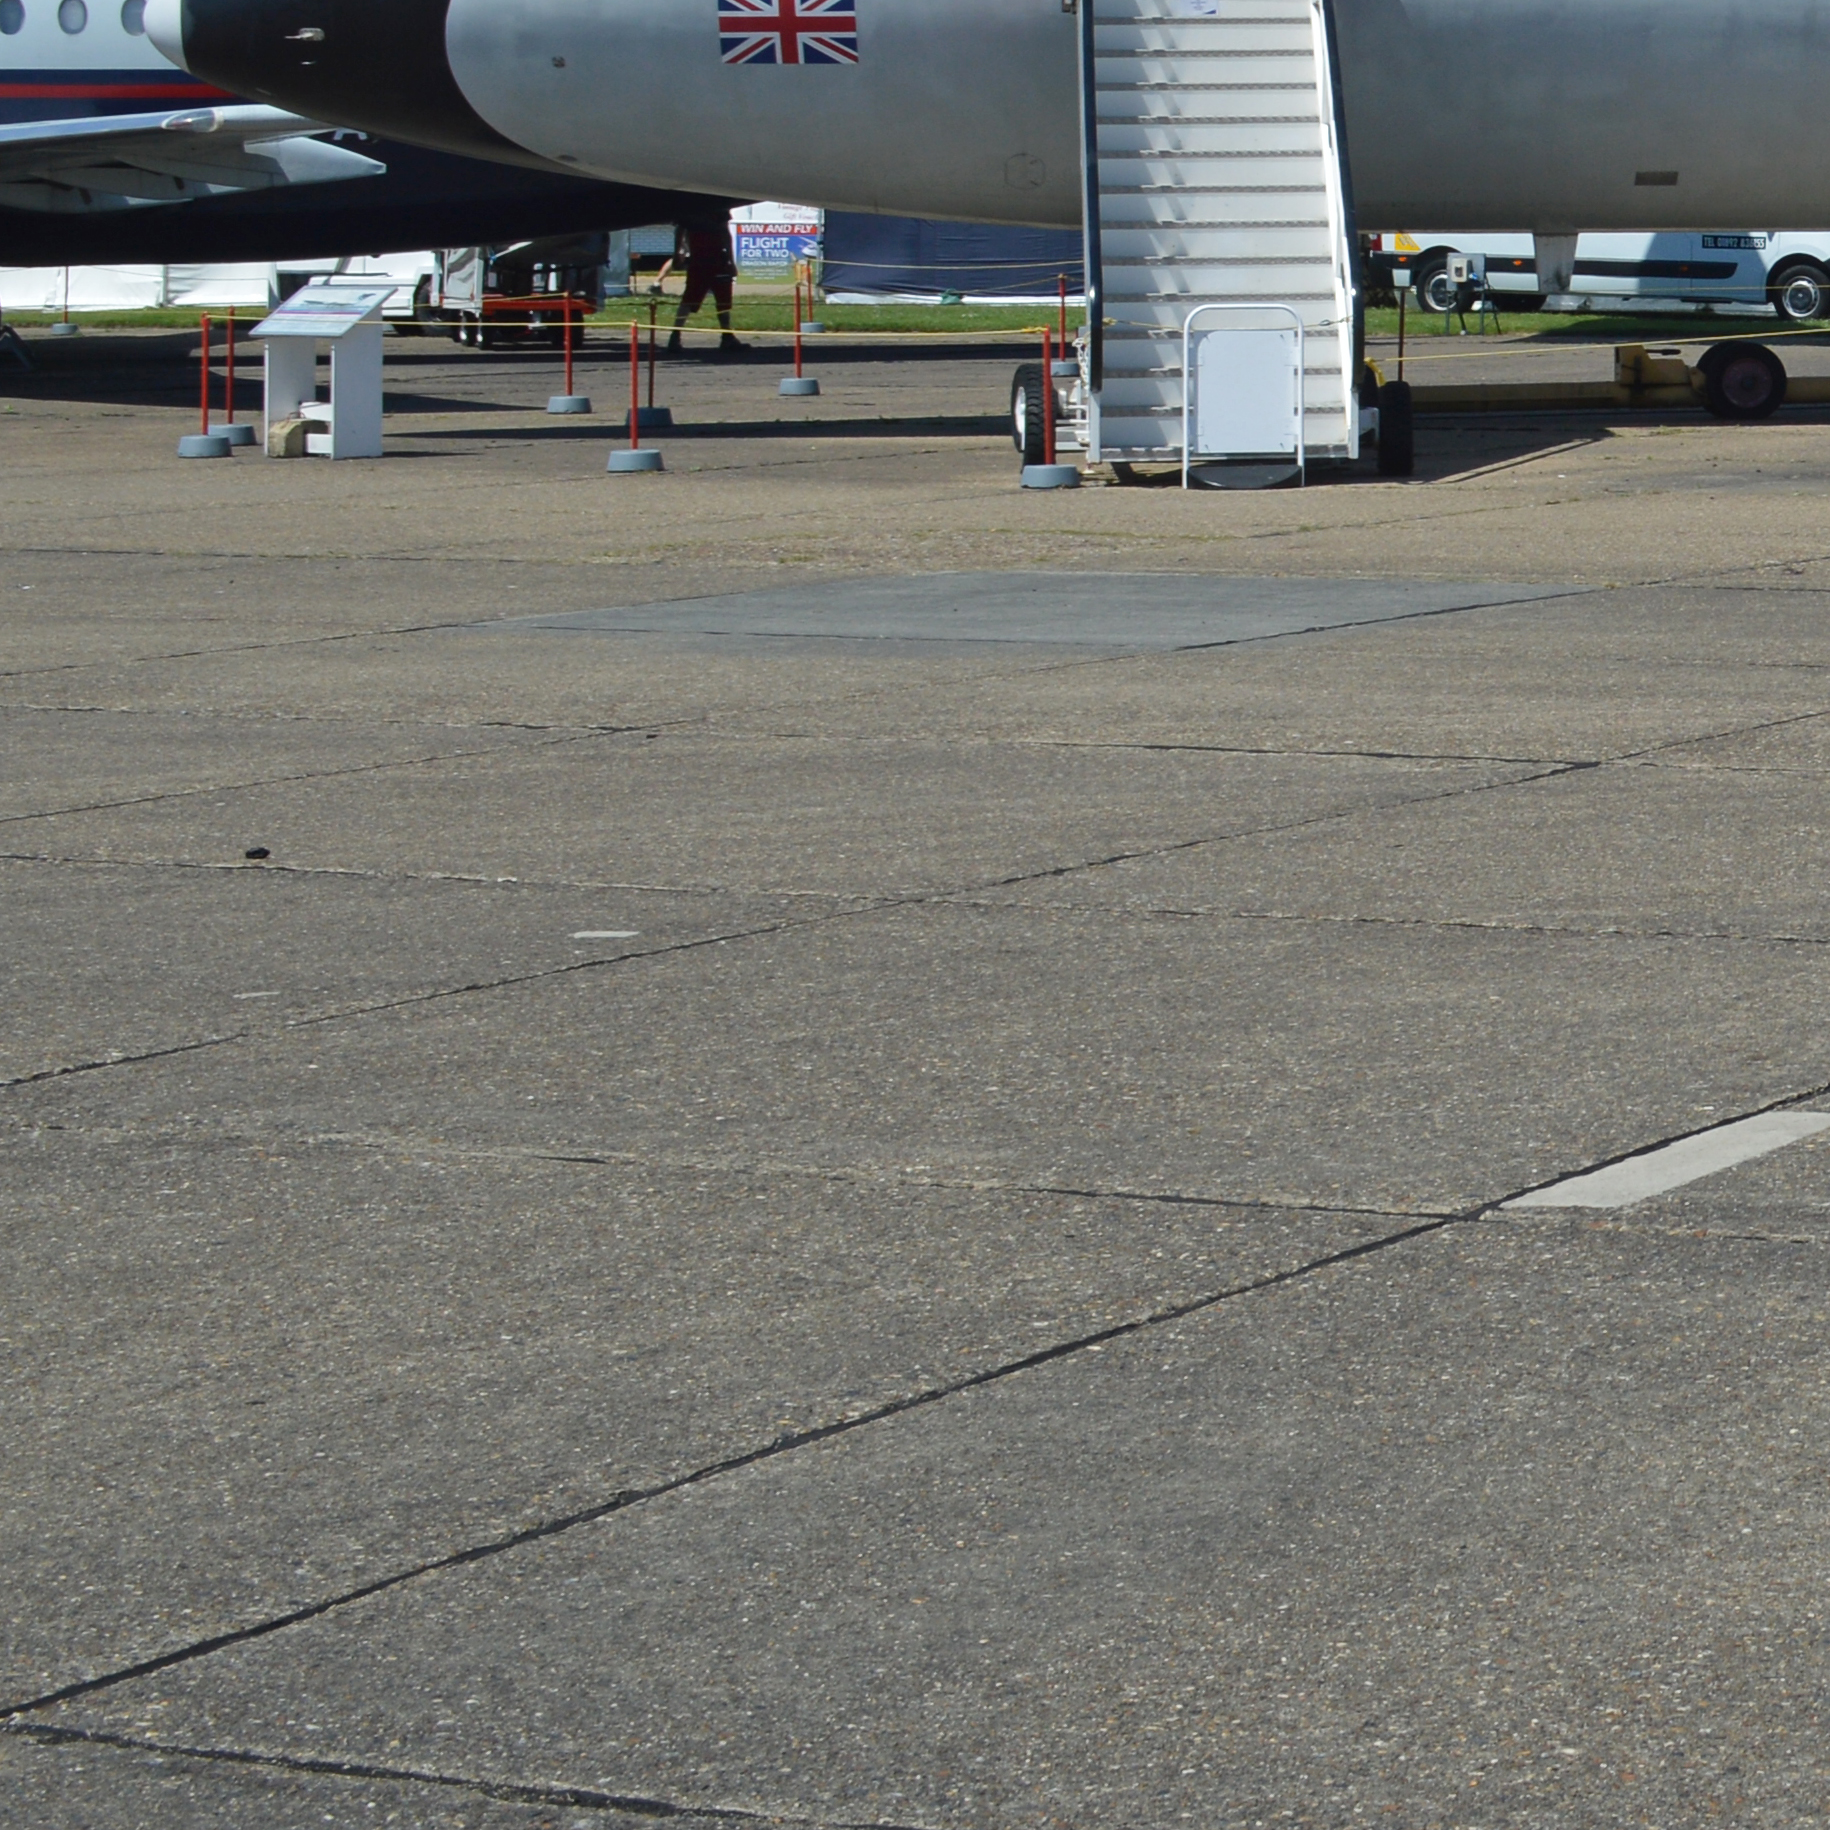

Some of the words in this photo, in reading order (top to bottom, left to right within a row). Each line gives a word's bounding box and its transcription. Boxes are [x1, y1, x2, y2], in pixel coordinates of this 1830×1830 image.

[741, 224, 764, 233] WIN
[766, 224, 792, 233] AND
[794, 224, 812, 233] FLY
[741, 237, 789, 249] FLIGHT
[741, 249, 762, 258] FOR
[765, 249, 789, 258] TWO
